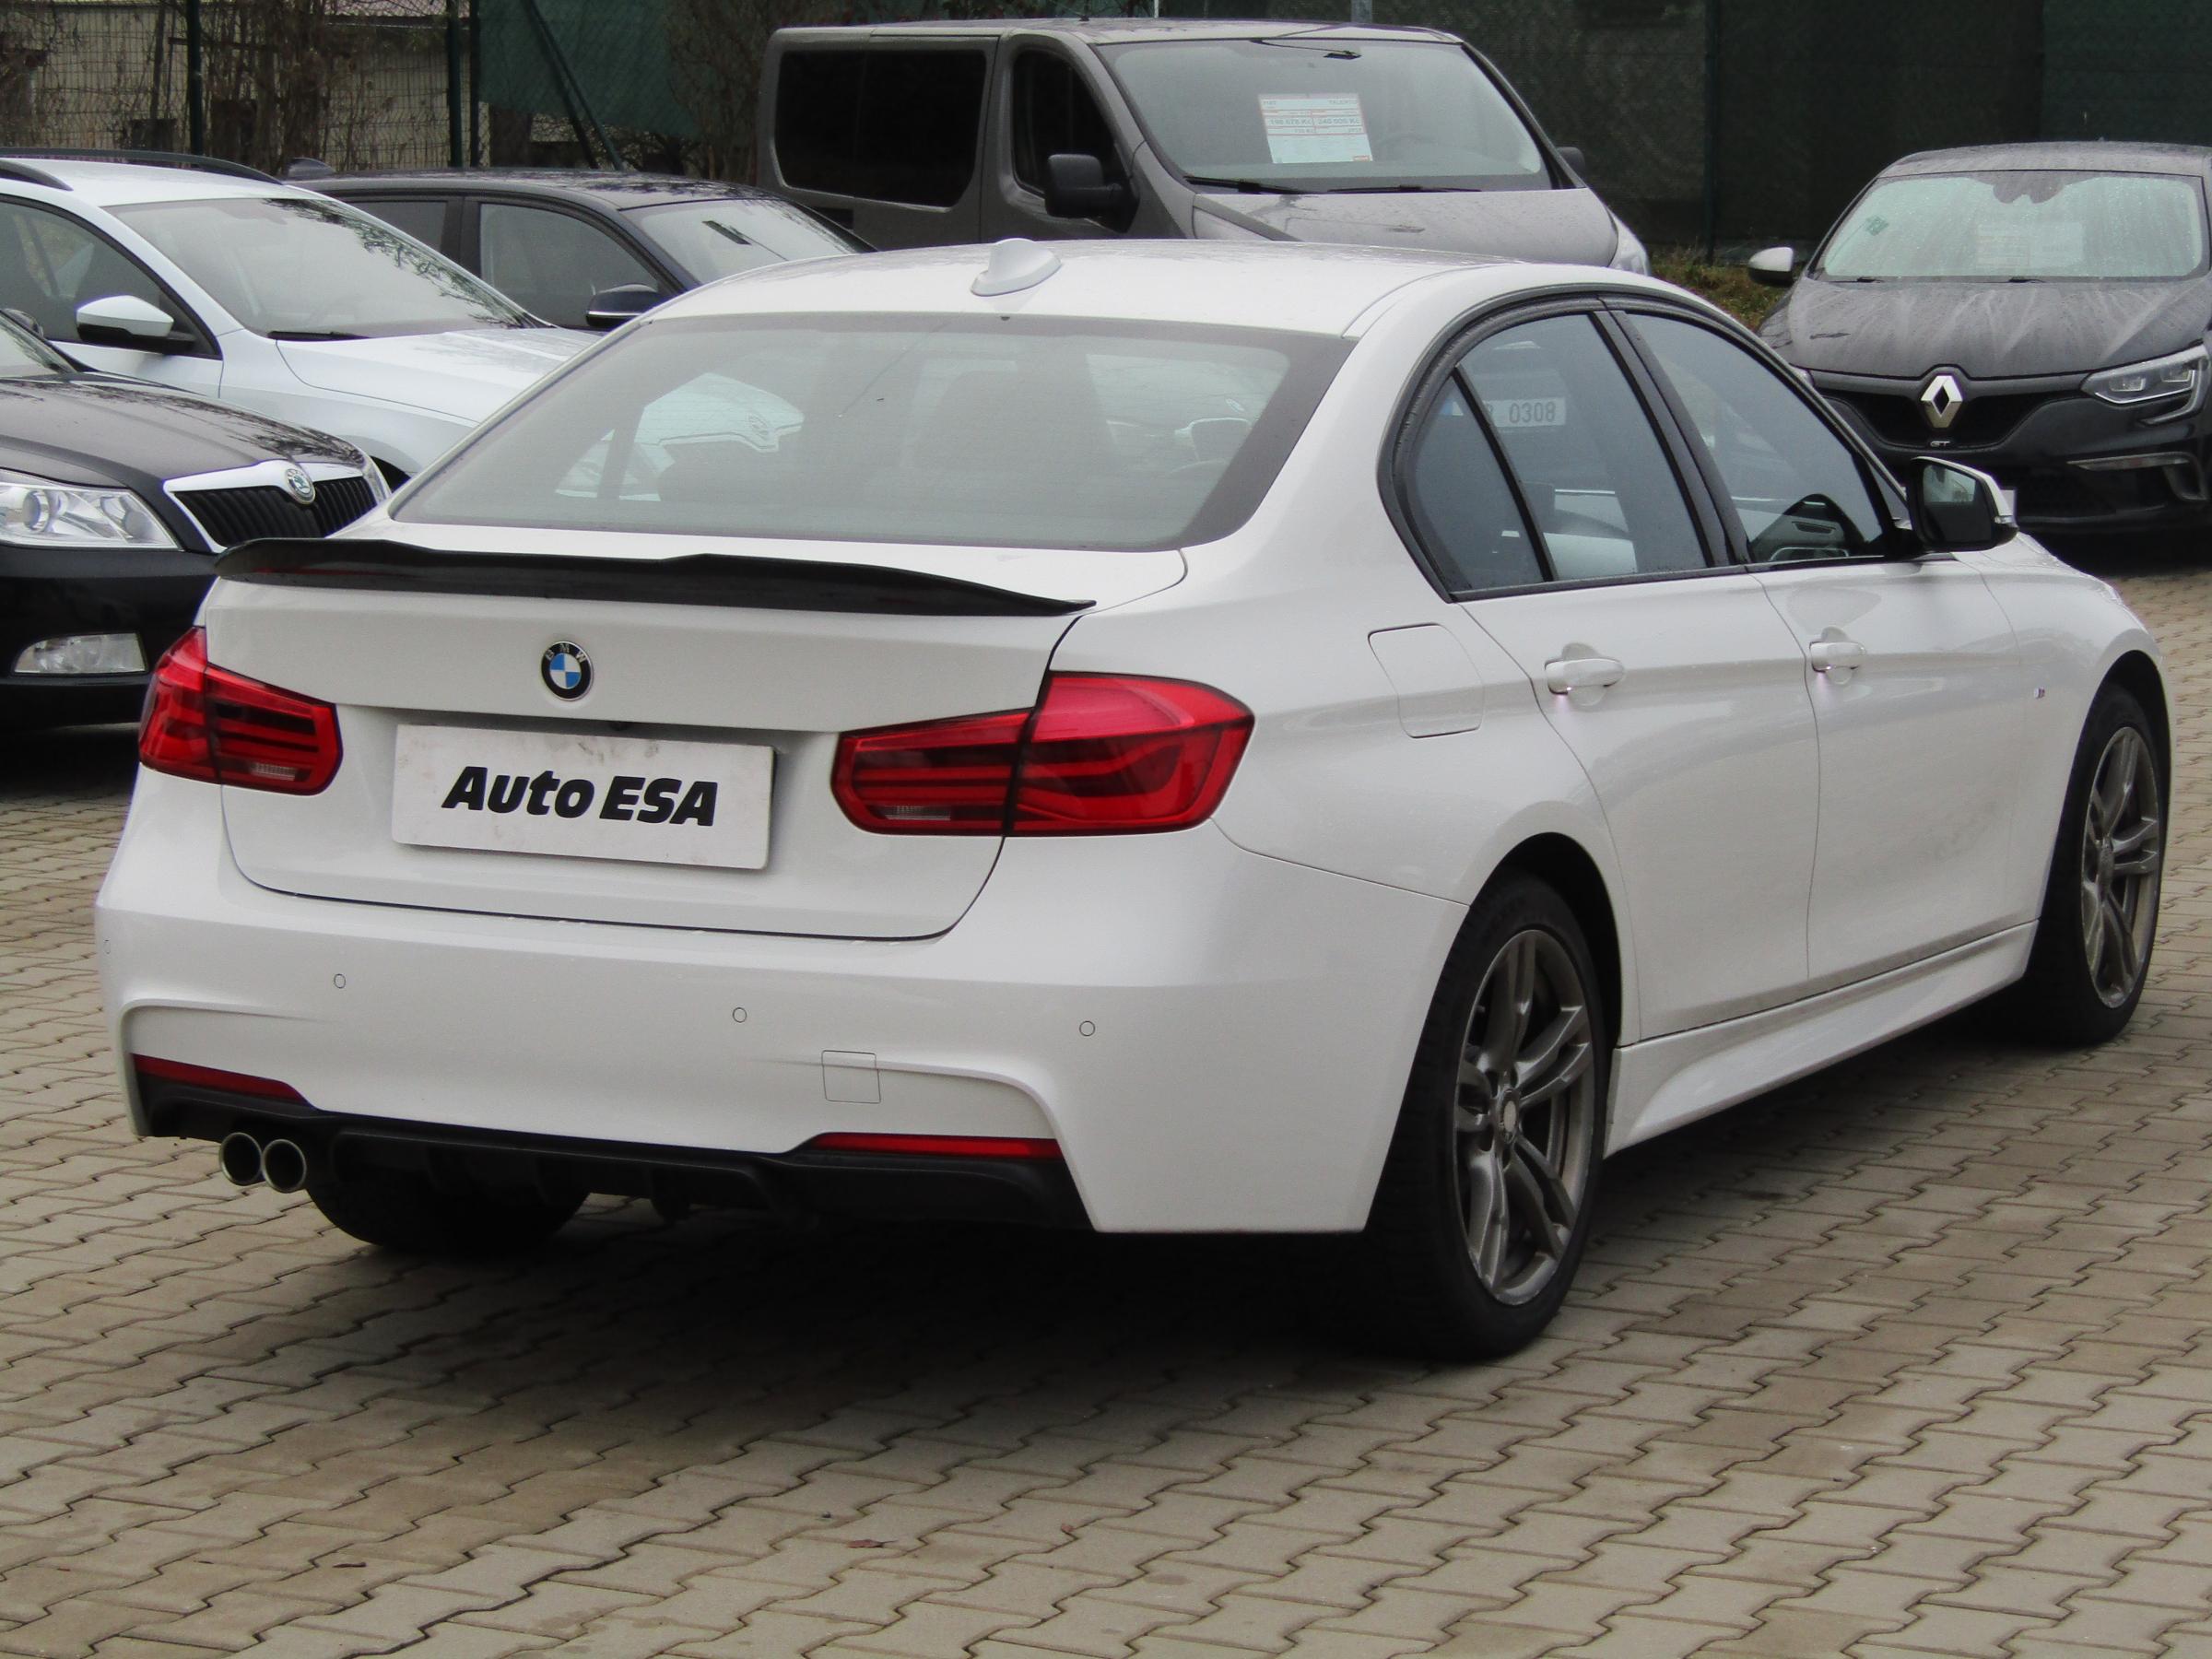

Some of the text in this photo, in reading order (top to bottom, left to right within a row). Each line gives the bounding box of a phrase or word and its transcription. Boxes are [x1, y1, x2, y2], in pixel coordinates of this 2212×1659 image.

[1510, 401, 1557, 424] 0308
[545, 642, 588, 664] BMW
[441, 766, 719, 827] Auto ESA
